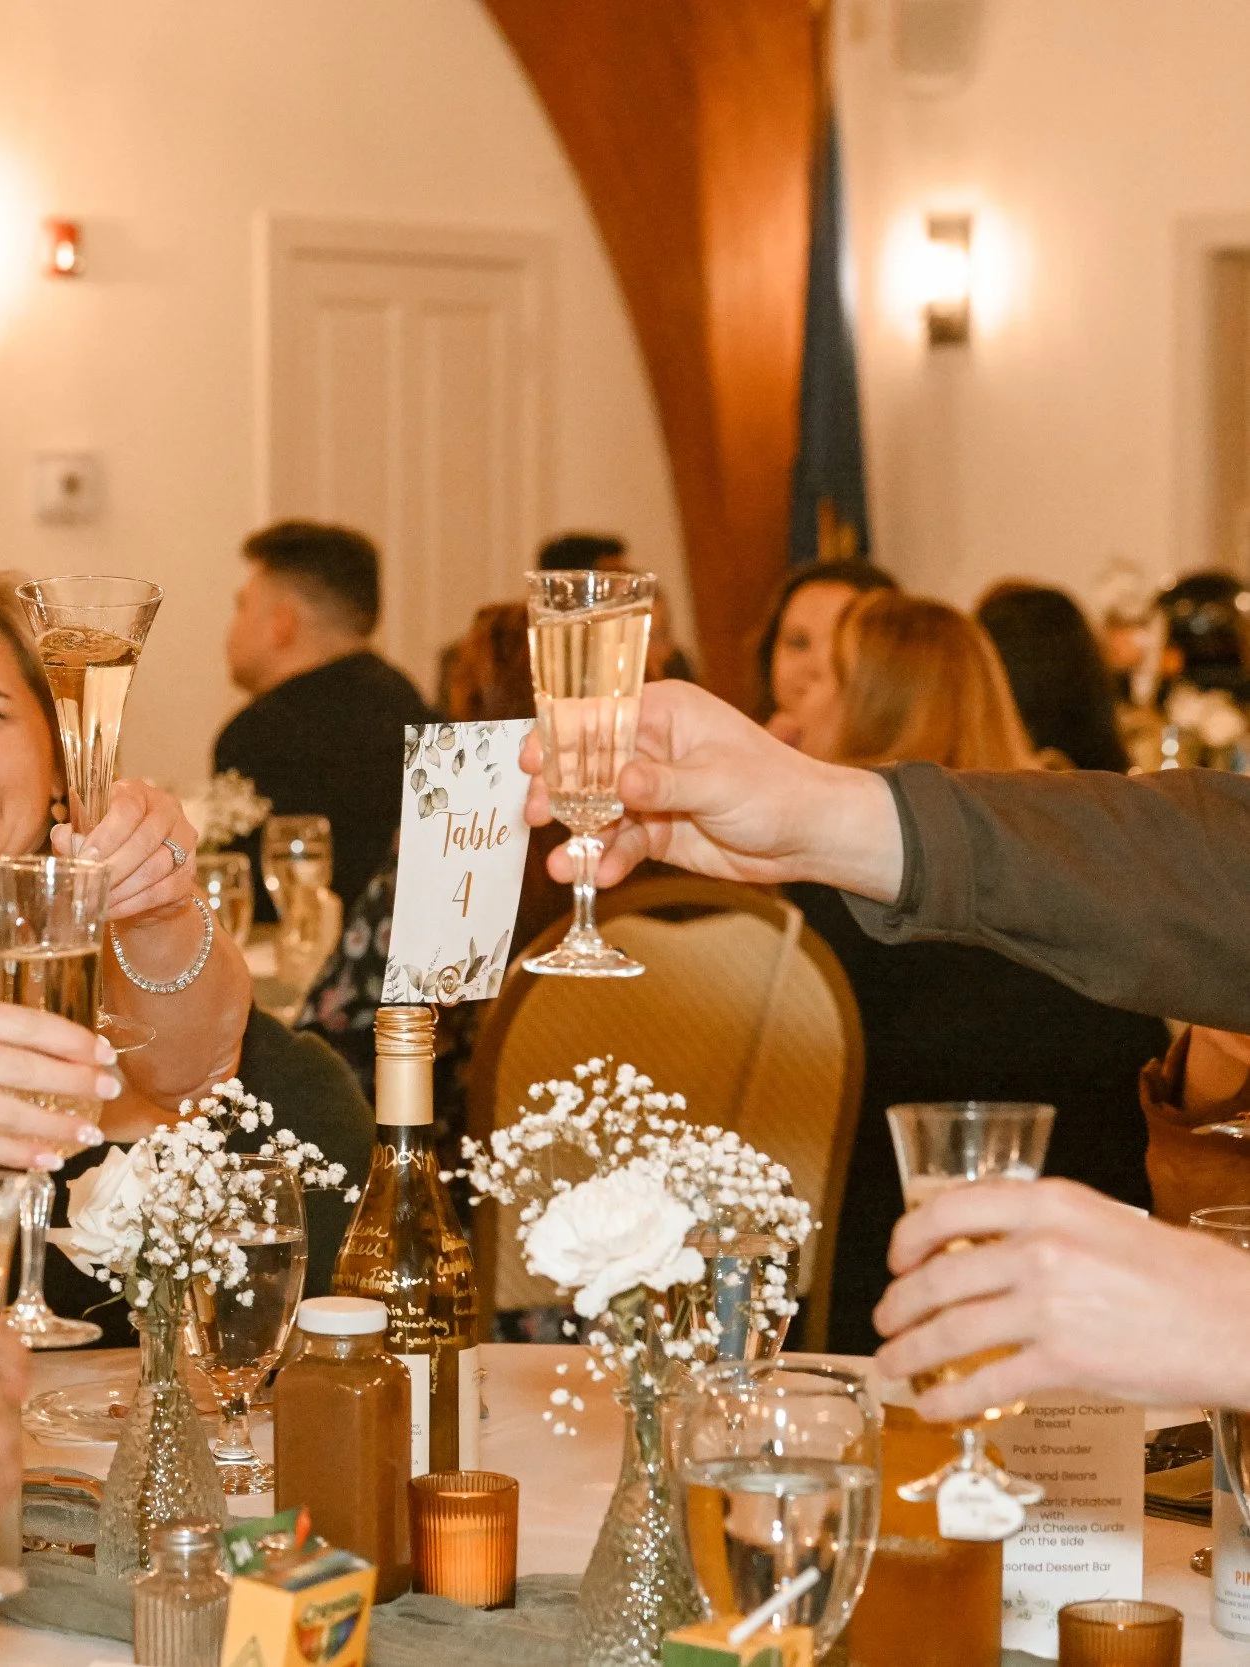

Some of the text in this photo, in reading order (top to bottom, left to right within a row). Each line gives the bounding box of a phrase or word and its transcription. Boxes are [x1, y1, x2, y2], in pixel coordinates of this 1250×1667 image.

[432, 806, 510, 858] Table
[452, 870, 473, 917] 4
[1078, 1405, 1125, 1416] Chicken
[1034, 1419, 1071, 1429] Breast
[1013, 1445, 1092, 1455] Pork Shoulder
[1035, 1471, 1059, 1481] and
[1062, 1471, 1097, 1481] Beans
[1071, 1497, 1122, 1507] Potatoes
[1040, 1511, 1065, 1521] with
[1043, 1523, 1088, 1533] Cheese
[1091, 1522, 1125, 1533] Curds
[1019, 1537, 1085, 1547] on the side
[1046, 1562, 1090, 1573] Dessert
[1093, 1561, 1112, 1572] Bar
